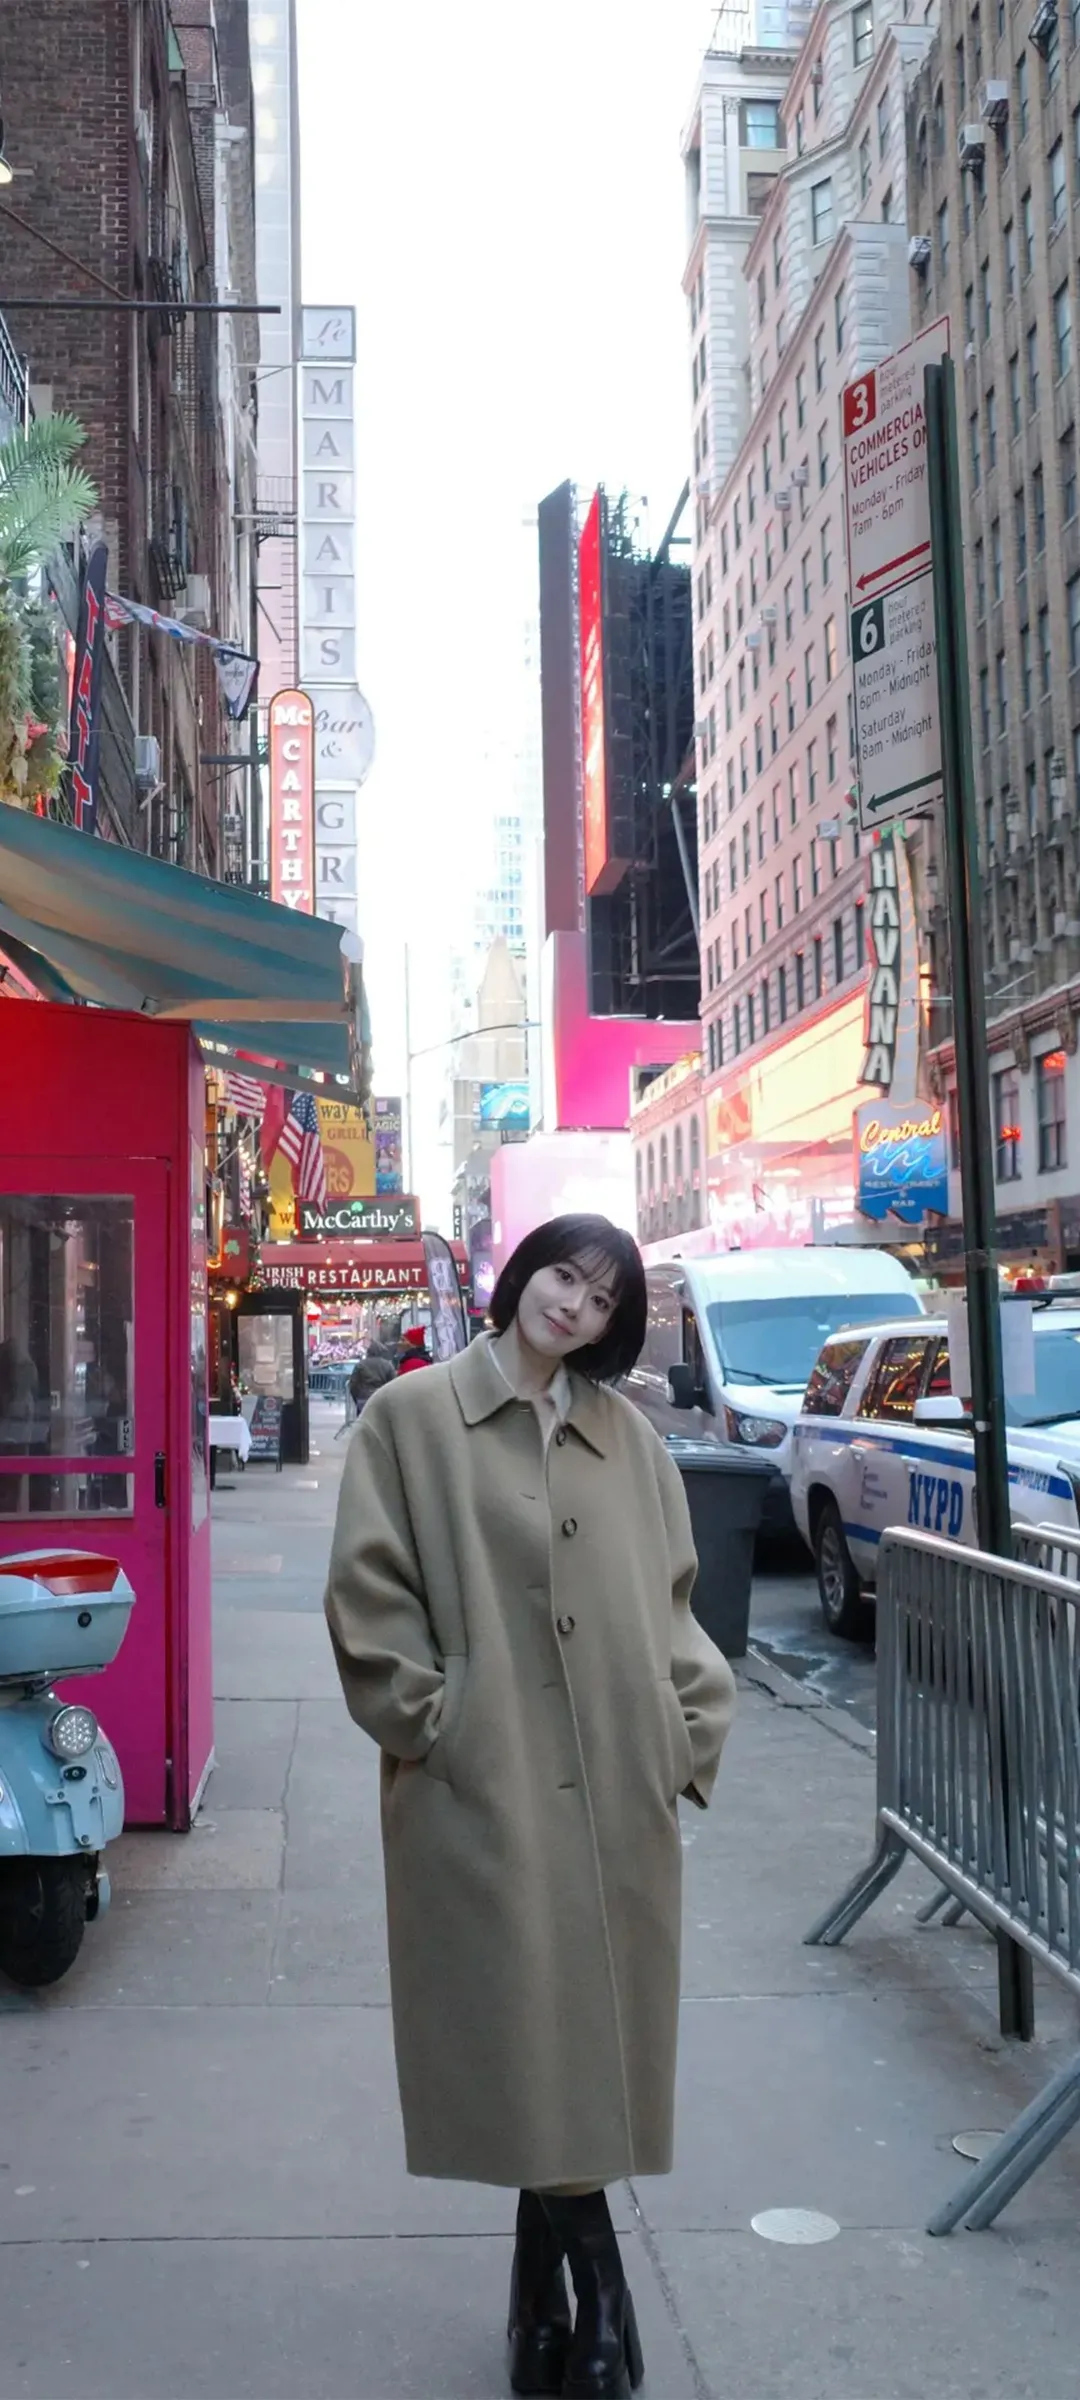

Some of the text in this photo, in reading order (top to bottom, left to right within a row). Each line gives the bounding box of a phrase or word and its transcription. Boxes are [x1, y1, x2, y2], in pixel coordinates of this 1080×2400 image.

[881, 363, 916, 397] metered
[852, 383, 868, 427] 3
[881, 384, 912, 416] parking
[850, 402, 923, 465] COMMERCIA
[851, 437, 908, 489] VEHICLES
[852, 488, 888, 520] Monday
[896, 463, 925, 490] Friday
[311, 378, 343, 666] MARAIS
[852, 517, 873, 538] 7am
[882, 498, 904, 521] 6pm
[861, 608, 878, 653] 6
[889, 600, 926, 629] metered
[890, 618, 923, 645] parking
[859, 661, 897, 689] Monday
[860, 690, 881, 710] 6pm
[889, 663, 930, 696] Midnight
[72, 580, 100, 831] TATT
[315, 709, 363, 733] Bar
[861, 707, 906, 740] Saturday
[320, 741, 343, 759] &
[862, 740, 884, 760] 8am
[892, 713, 932, 748] Midnight
[864, 850, 899, 1084] HAVANA
[320, 1103, 351, 1123] way
[860, 1111, 941, 1152] Central
[304, 1207, 413, 1231] McCarthy's
[266, 1266, 304, 1278] IRISH
[271, 1277, 299, 1288] PUB
[307, 1267, 422, 1285] RESTAURANT
[908, 1473, 964, 1537] NYPD
